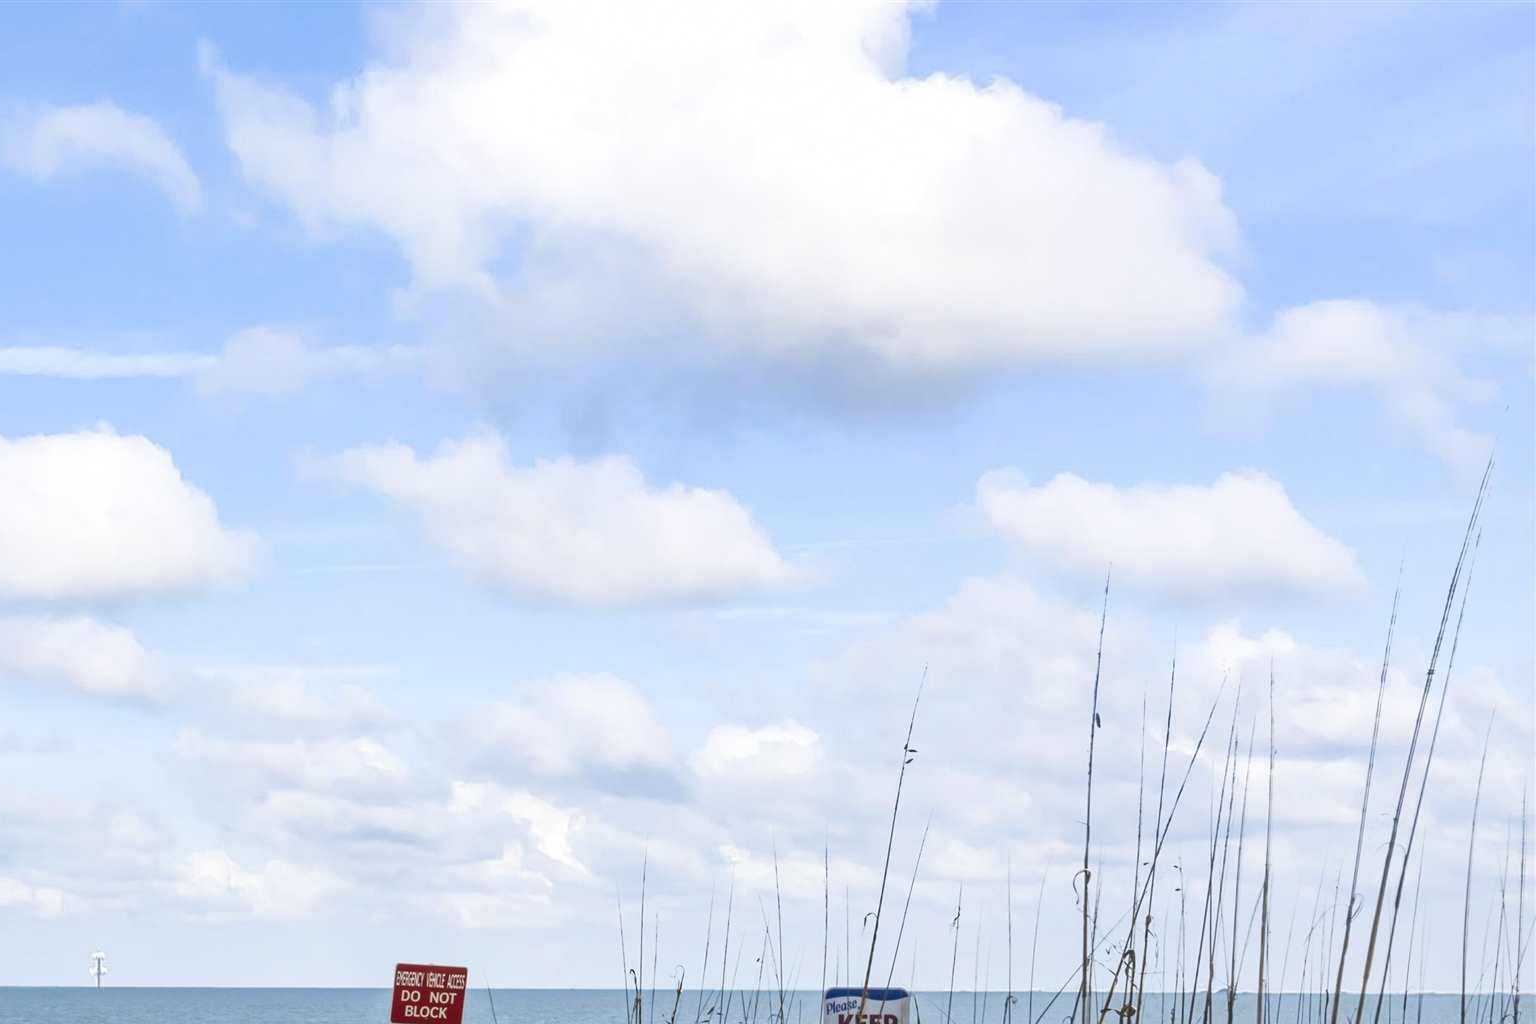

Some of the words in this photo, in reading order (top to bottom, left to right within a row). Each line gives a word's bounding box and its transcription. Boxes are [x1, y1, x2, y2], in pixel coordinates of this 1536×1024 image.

[426, 972, 446, 989] VEHICLE
[447, 974, 466, 990] ACCESS
[401, 990, 421, 1002] DO
[429, 991, 457, 1004] NOT
[405, 1005, 448, 1019] BLOCK
